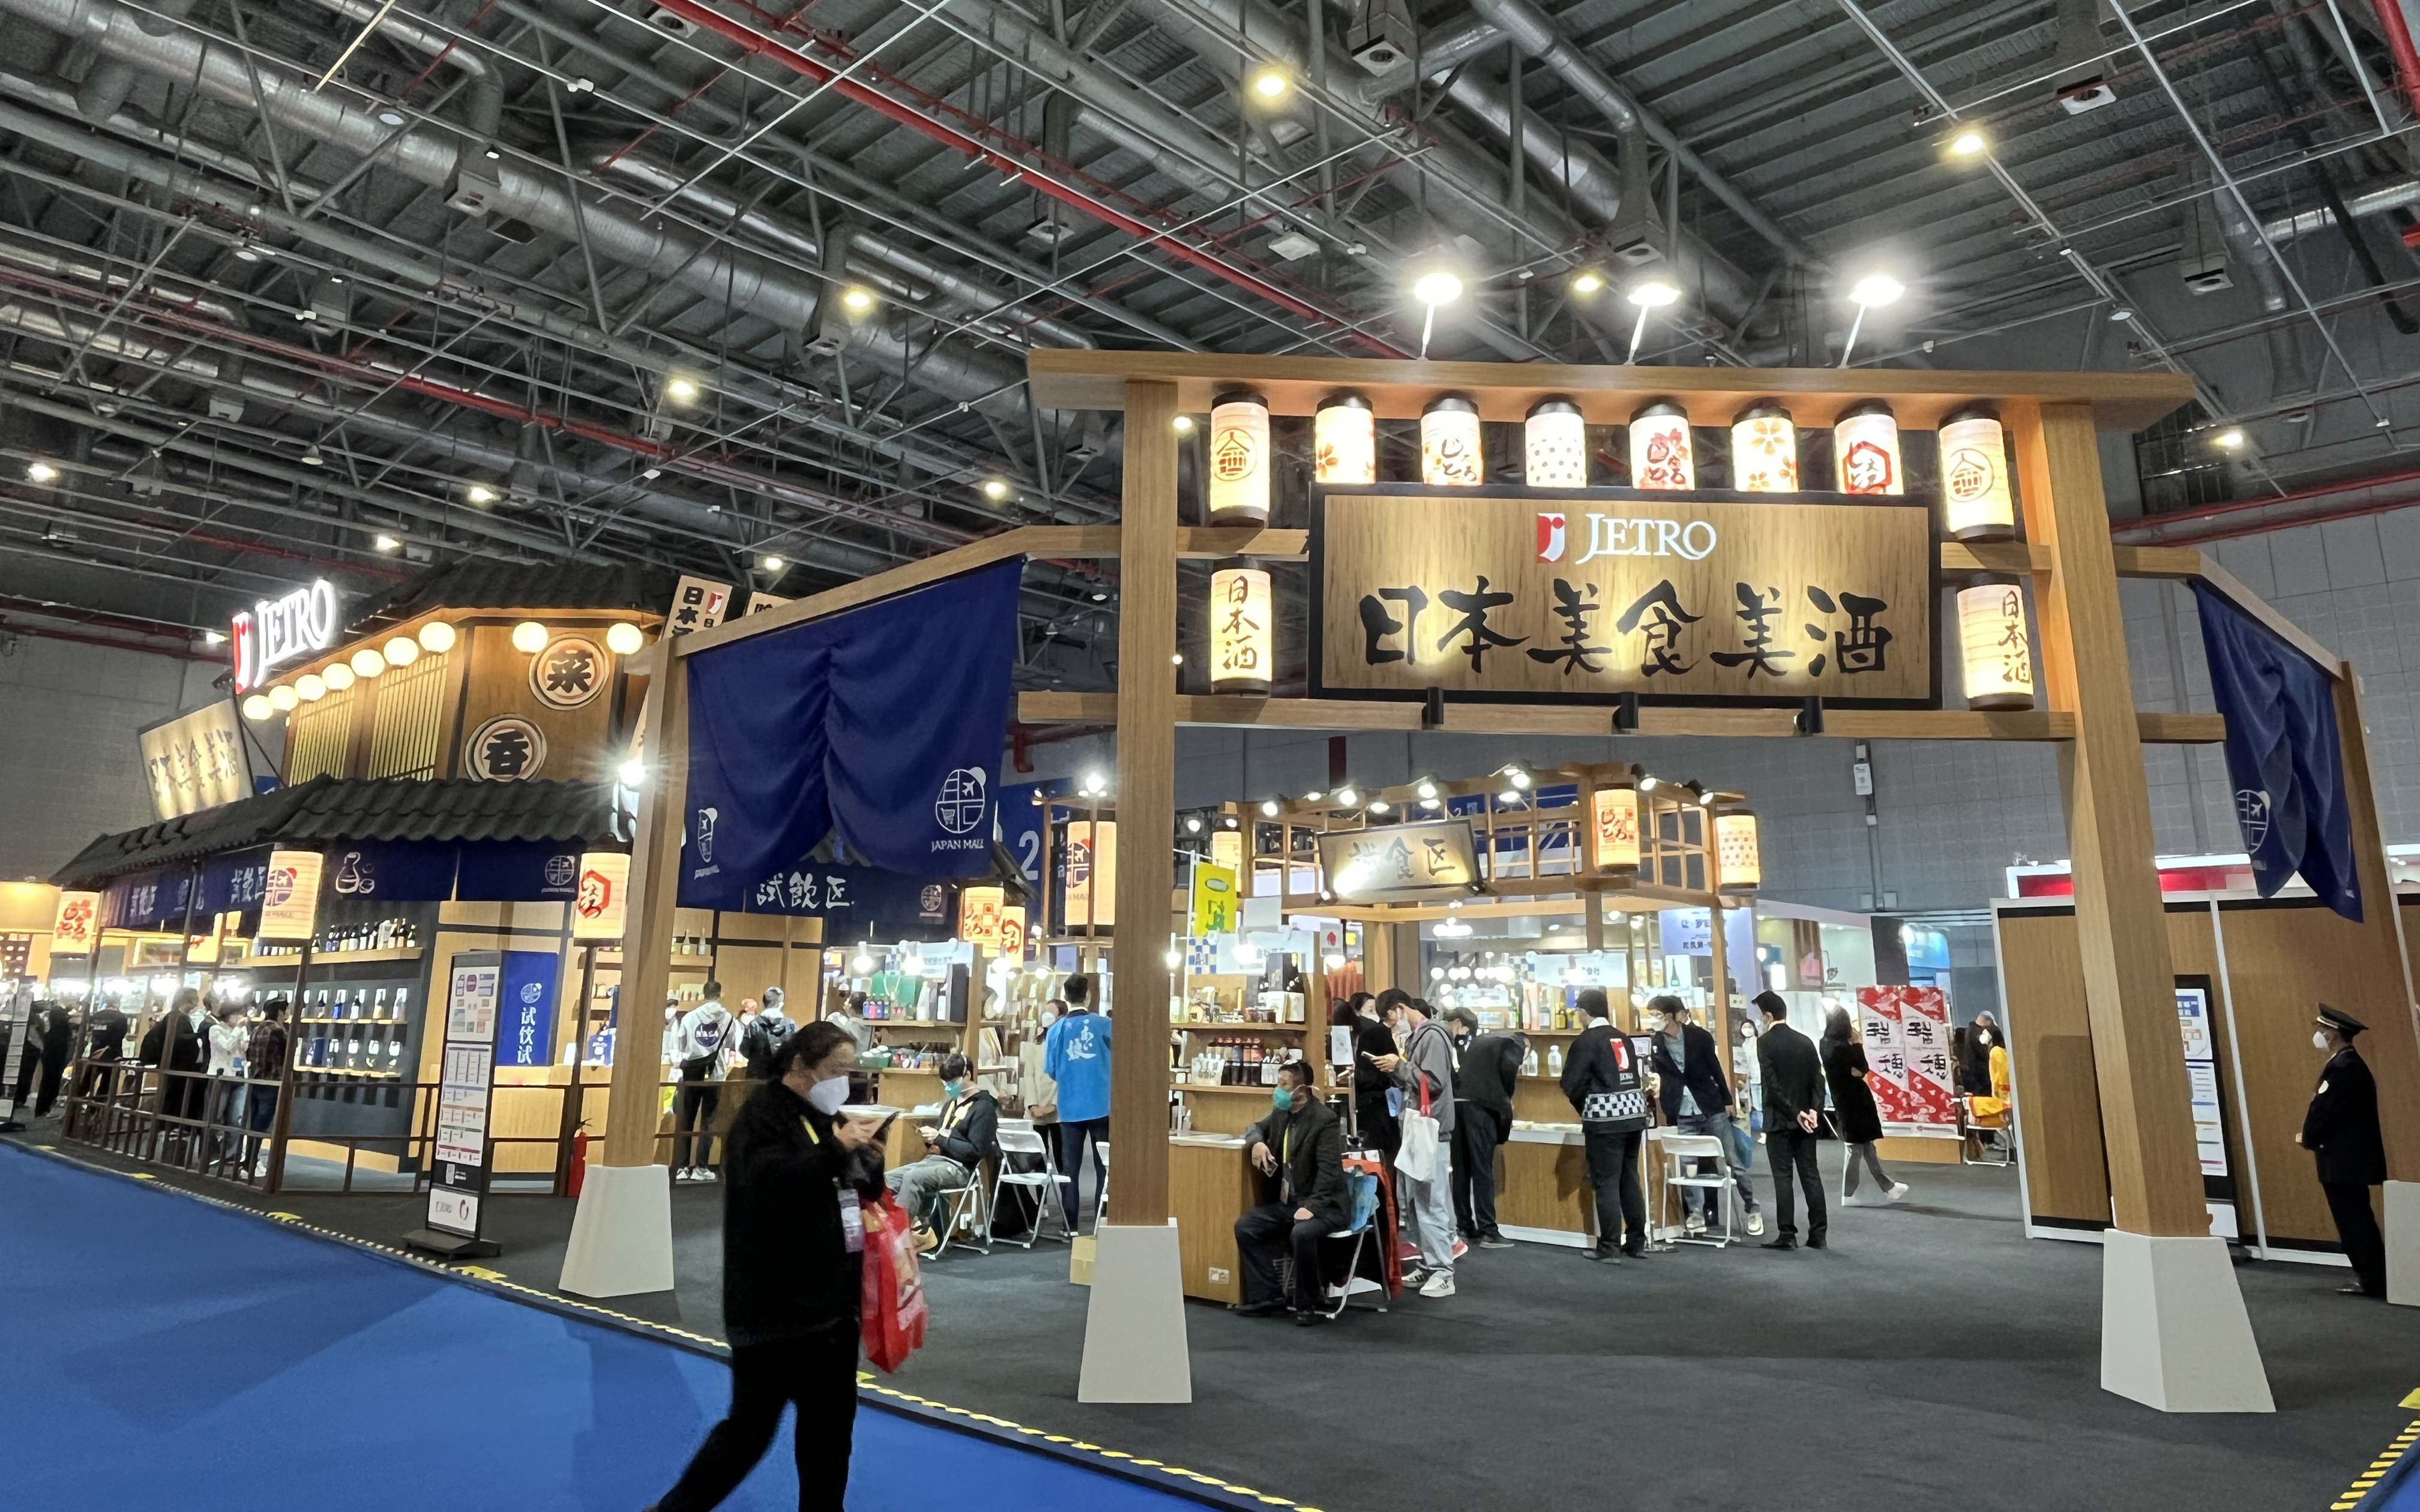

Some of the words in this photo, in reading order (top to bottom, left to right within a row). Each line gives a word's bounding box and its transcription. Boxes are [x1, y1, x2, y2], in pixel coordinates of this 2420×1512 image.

[1576, 514, 1717, 565] JETRO
[253, 579, 334, 688] JETRO
[1223, 575, 1259, 670] 日本酒
[1359, 575, 1892, 679] 日本美食美酒
[1998, 590, 2032, 684] 日本酒
[931, 840, 961, 852] JAPAN
[963, 839, 984, 849] MALL
[1019, 830, 1040, 880] 2
[757, 872, 850, 909] 試飲区
